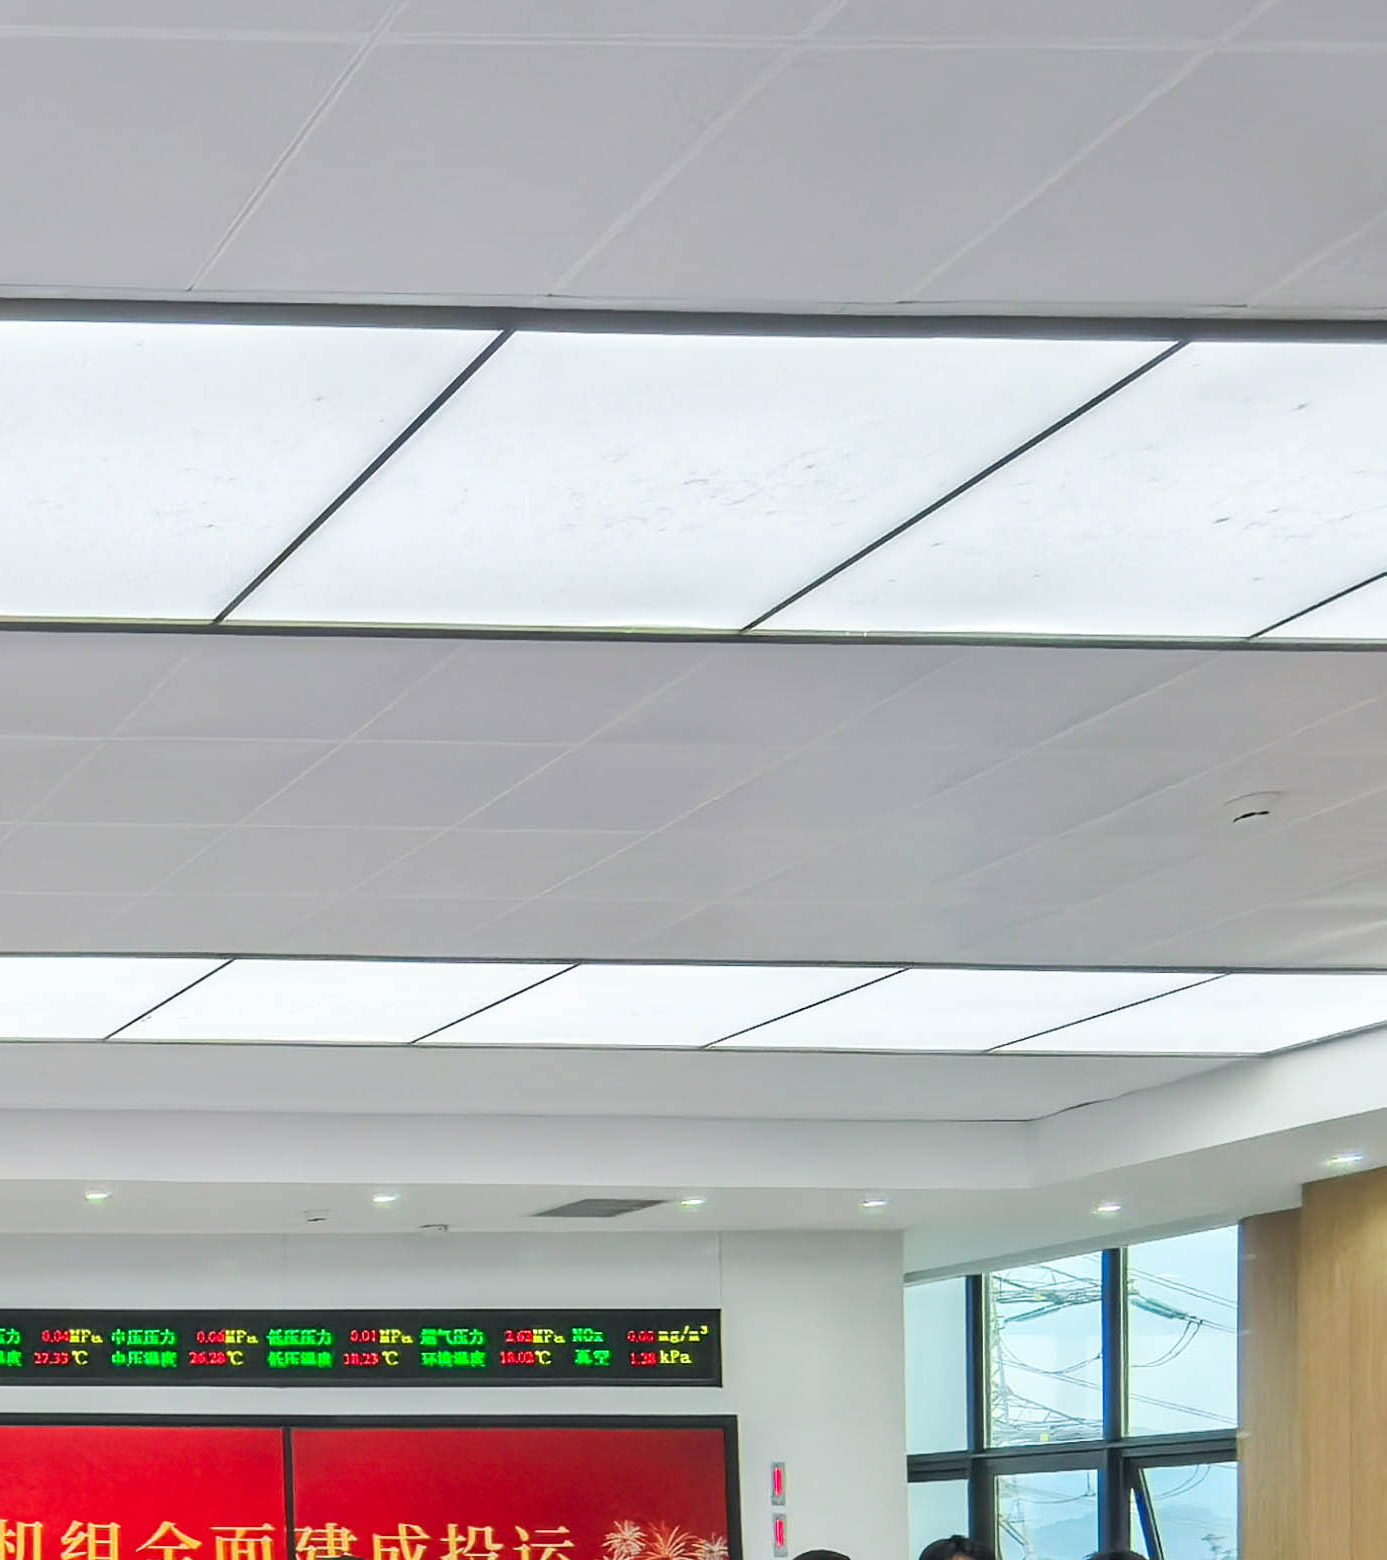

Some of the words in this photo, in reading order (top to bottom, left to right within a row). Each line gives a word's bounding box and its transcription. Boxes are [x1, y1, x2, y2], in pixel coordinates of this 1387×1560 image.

[111, 1329, 176, 1345] 中压压力
[266, 1329, 332, 1346] 低压压力
